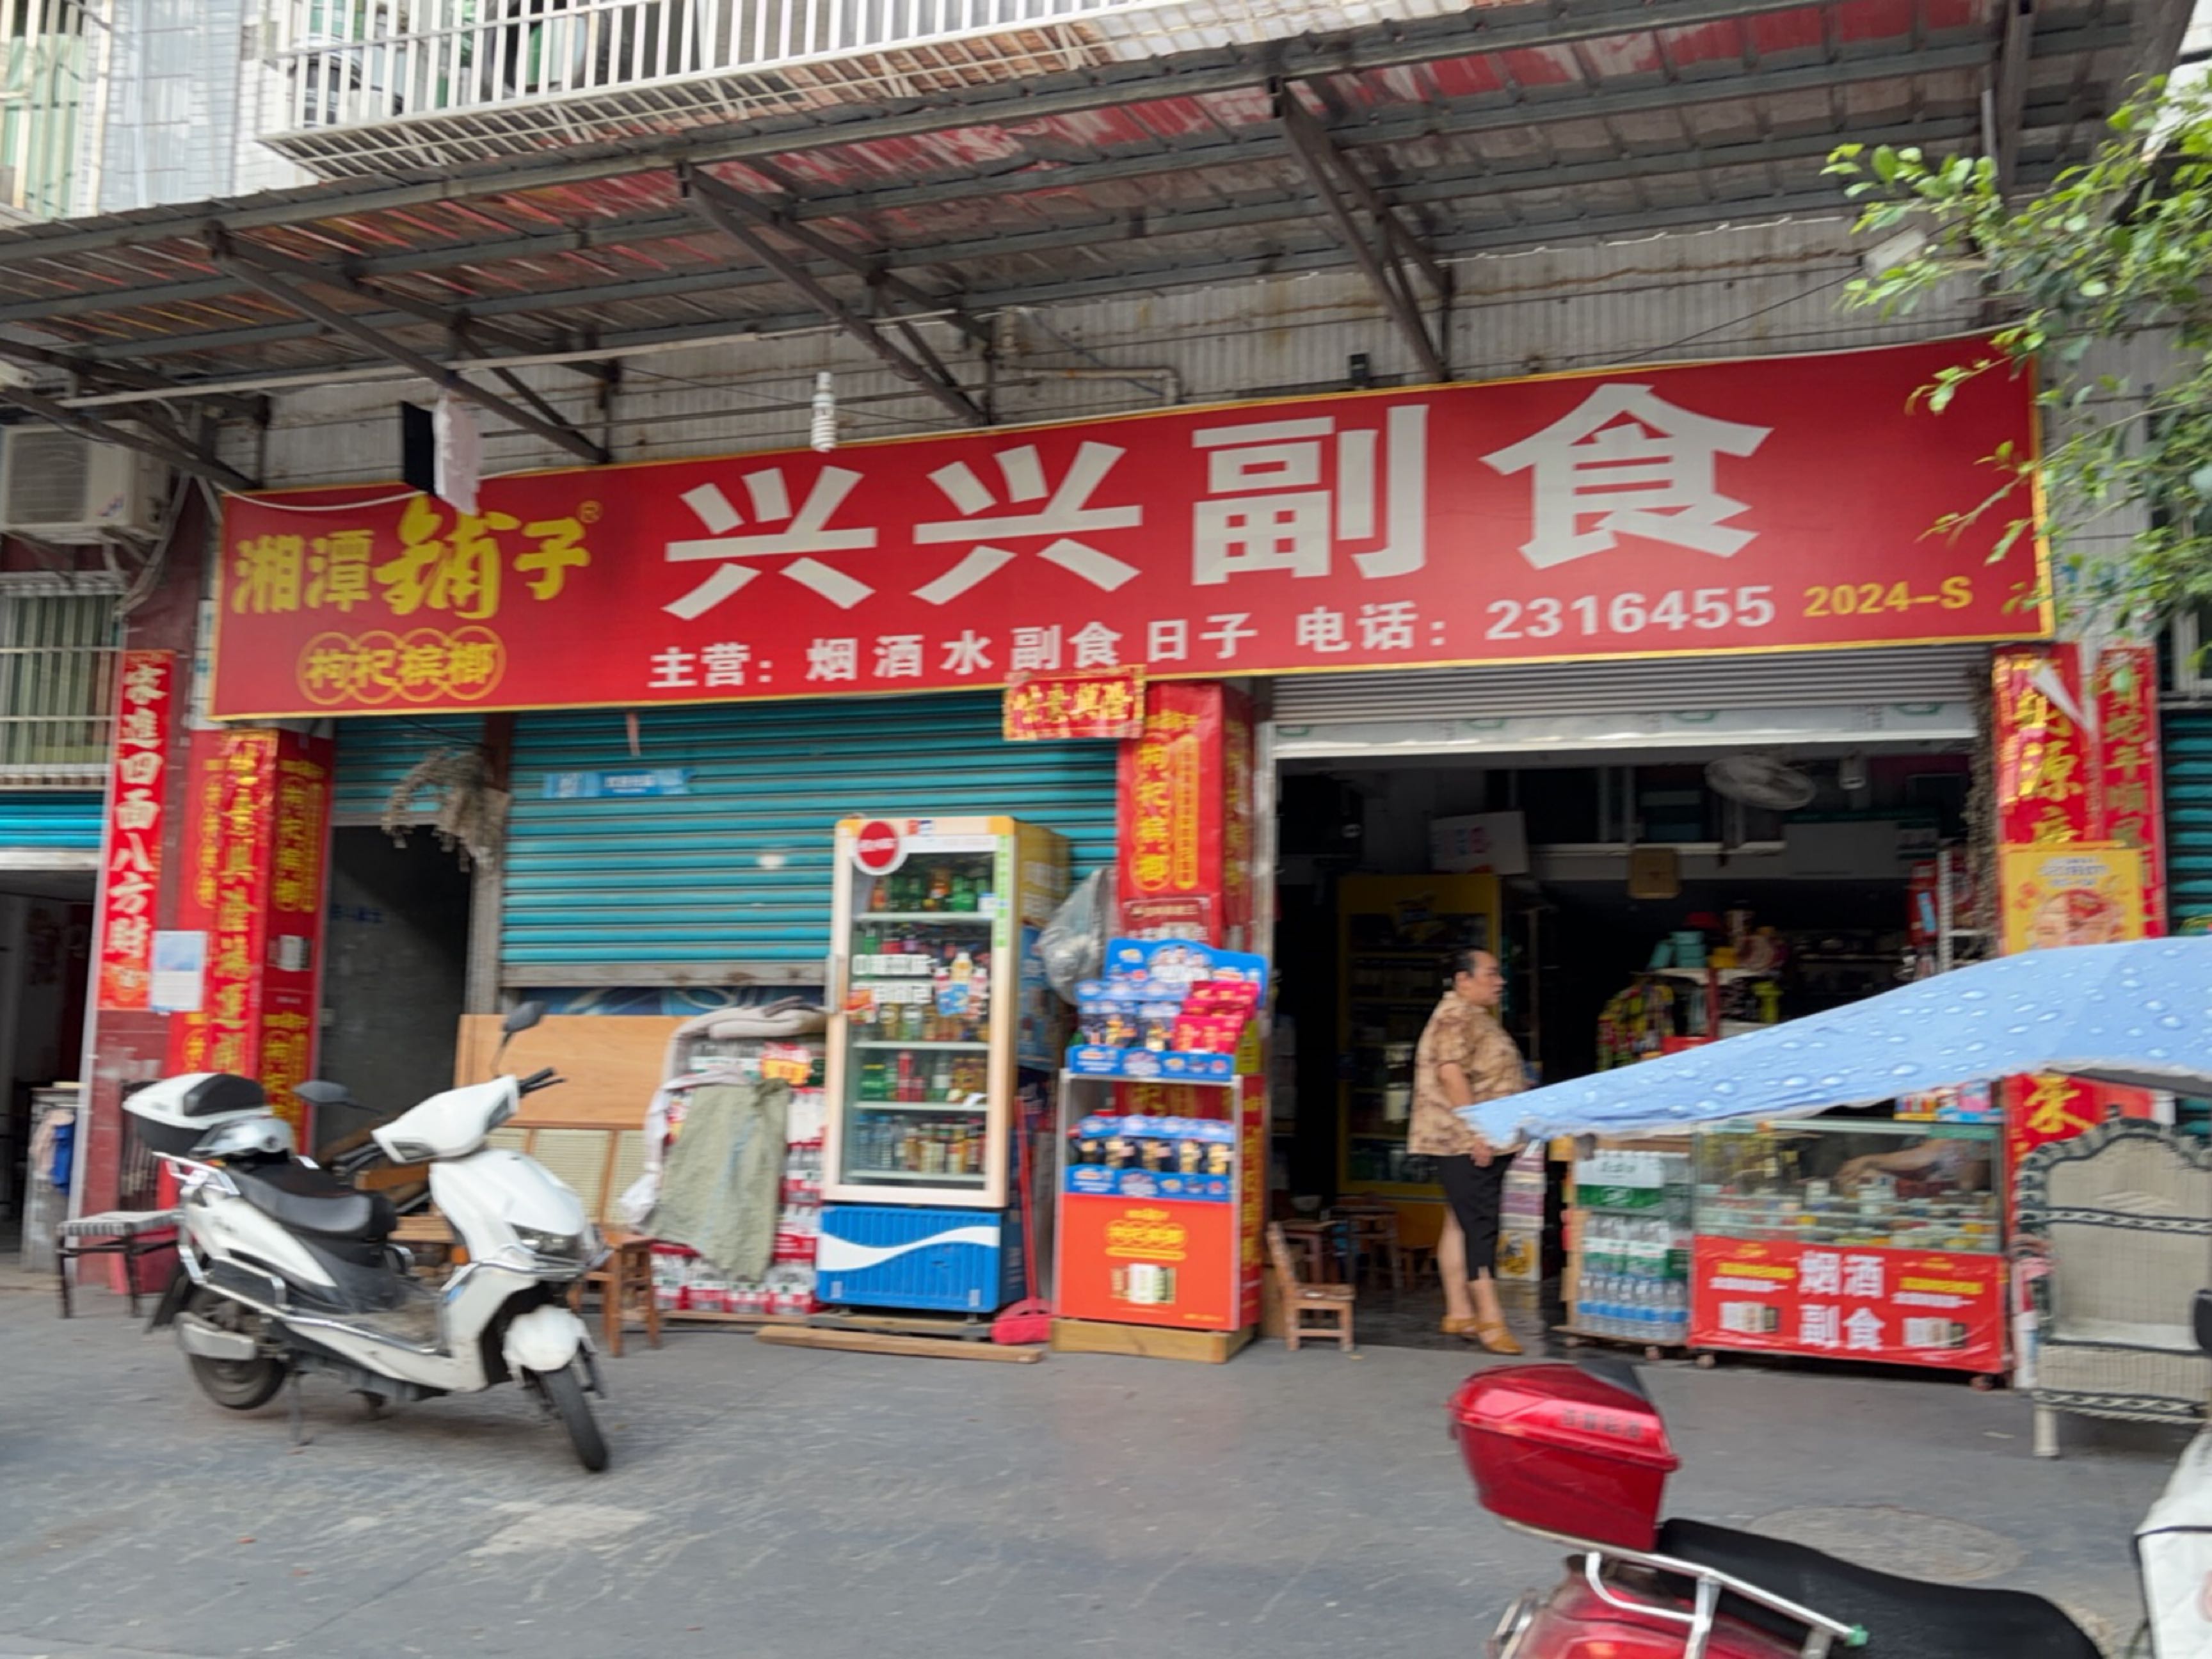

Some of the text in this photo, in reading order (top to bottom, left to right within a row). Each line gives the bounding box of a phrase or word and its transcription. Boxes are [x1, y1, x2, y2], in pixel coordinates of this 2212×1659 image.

[663, 383, 1773, 620] 兴兴副食
[230, 496, 591, 620] 湘潭铺子
[1486, 585, 1775, 641] 2316455
[304, 641, 497, 690] 枸杞槟榔
[1797, 1250, 1886, 1298] 烟酒
[1799, 1304, 1886, 1350] 副食
